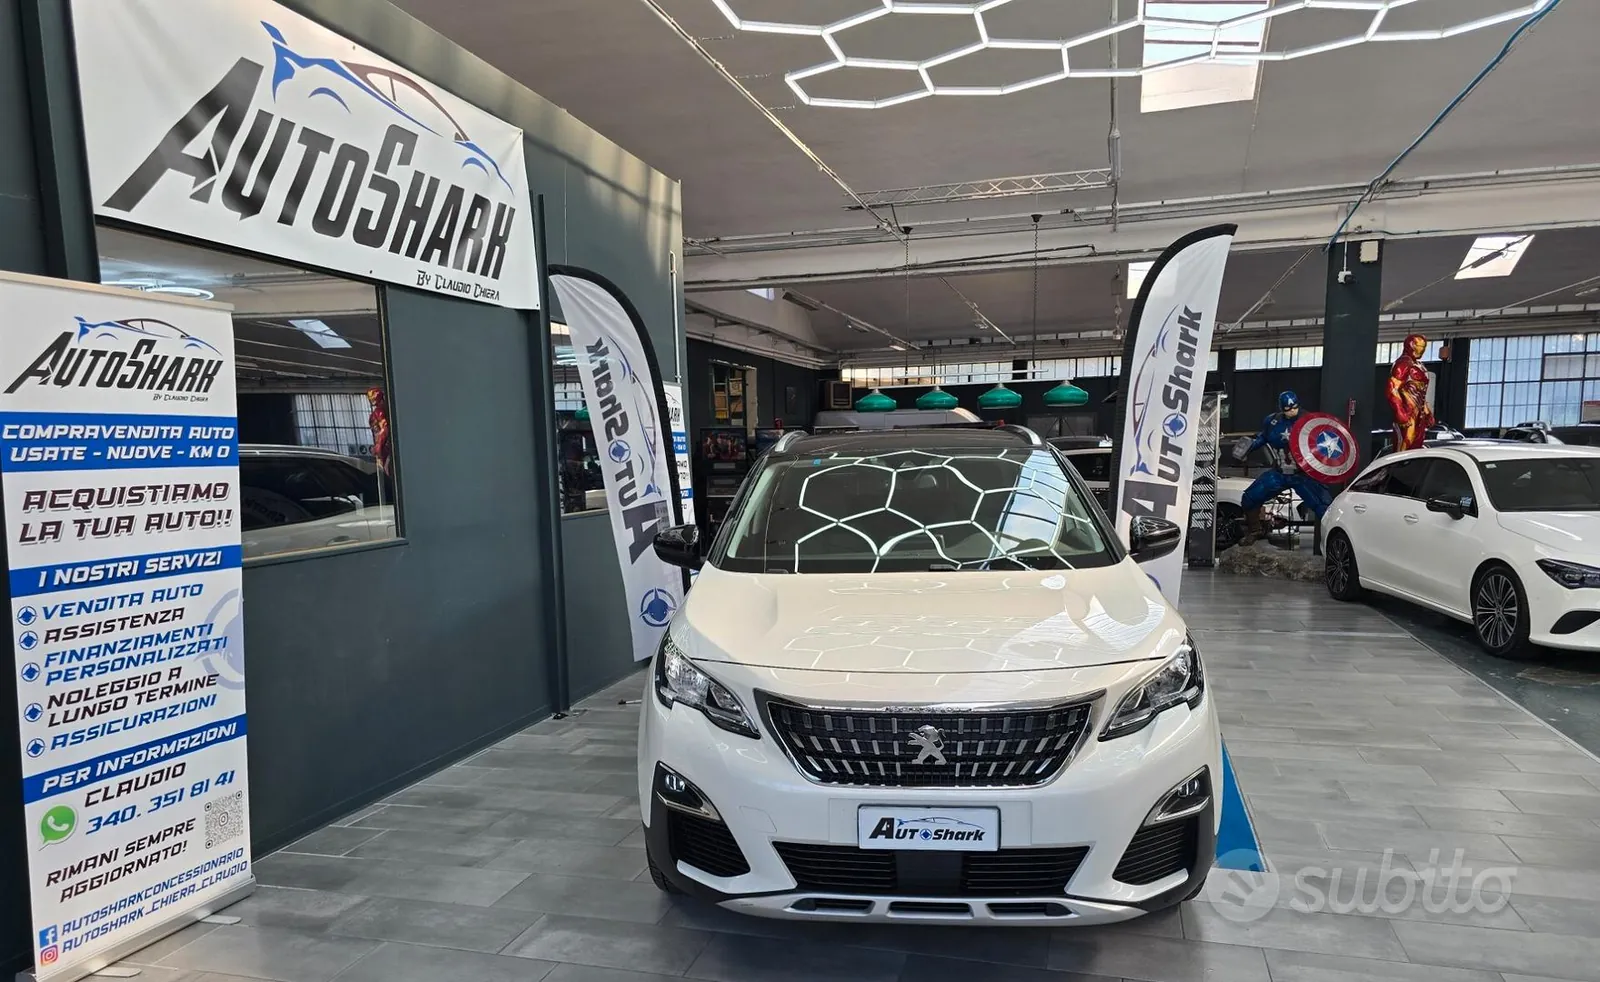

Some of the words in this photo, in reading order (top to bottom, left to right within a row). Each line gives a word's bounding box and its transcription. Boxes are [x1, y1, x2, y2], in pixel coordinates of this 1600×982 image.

[102, 56, 516, 281] AUTOSHARK
[416, 269, 431, 286] BY
[435, 274, 471, 294] CLAUDIO
[473, 282, 500, 301] CHIERA
[3, 331, 224, 394] AUTOSHARK
[2, 424, 183, 440] COMPRAVENDITA
[188, 426, 235, 440] AUTO
[10, 446, 88, 462] USATE
[106, 445, 173, 460] NUOVE
[189, 445, 213, 459] KM
[22, 482, 230, 512] ACQUISTIAMO
[18, 520, 63, 545] LA
[72, 515, 136, 541] TUA
[144, 508, 233, 534] AUTO!!
[38, 571, 47, 588] I
[53, 560, 139, 586] NOSTRI
[144, 550, 222, 574] SERVIZI
[42, 592, 145, 620] VENDITA
[150, 583, 204, 604] AUTO
[43, 607, 185, 645] ASSISTENZA
[44, 623, 214, 668] FINANZIAMENTI
[45, 636, 228, 687] PERSONALIZZATI
[47, 670, 162, 710] NOLEGGIO
[168, 666, 183, 681] A
[48, 695, 134, 728] LUNGO
[135, 673, 220, 706] TERMINE
[50, 693, 217, 751] ASSICURAZIONI
[41, 769, 92, 794] PER
[95, 722, 237, 778] INFORMAZIONI
[84, 762, 187, 808] CLAUDIO
[148, 787, 185, 814] 351
[190, 778, 210, 798] 81
[214, 769, 236, 787] 41
[46, 848, 120, 888] RIMANI
[124, 818, 197, 858] SEMPRE
[60, 840, 188, 903] AGGIORNATO!
[61, 847, 245, 937] AUTOSHARKCONCESSIONARIO
[62, 860, 248, 953] AUTOSHARK_CHIERA_CLAUDIO
